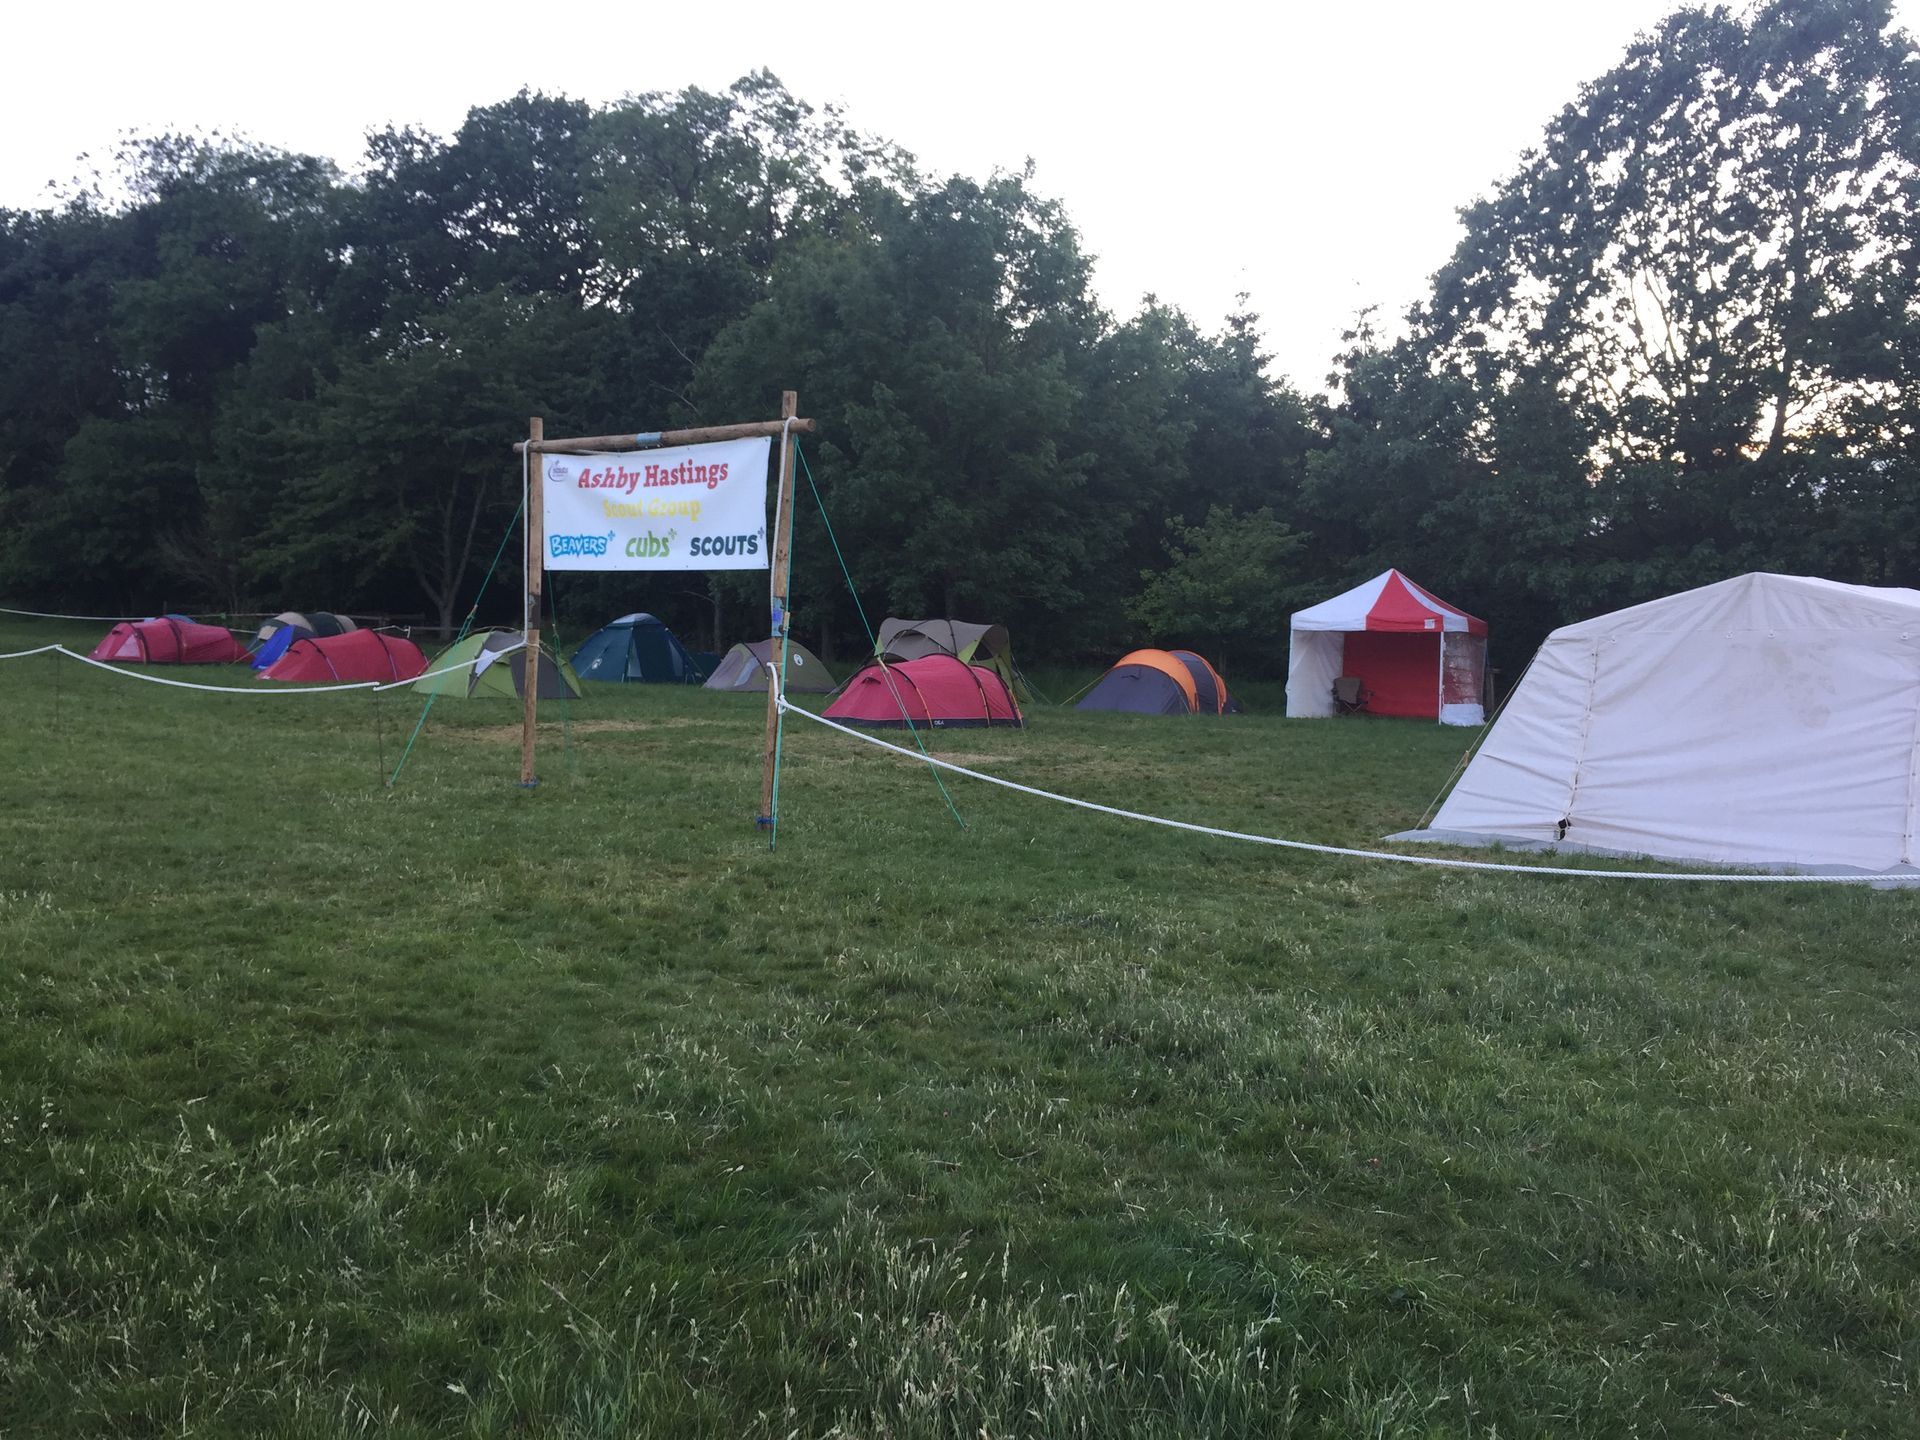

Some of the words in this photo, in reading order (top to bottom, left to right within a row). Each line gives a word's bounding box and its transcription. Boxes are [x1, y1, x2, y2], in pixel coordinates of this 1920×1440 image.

[577, 466, 640, 494] Ashby
[643, 459, 729, 490] Hastings
[648, 498, 702, 522] Group
[550, 534, 607, 557] BEAVERS
[690, 534, 758, 556] SCOUTS
